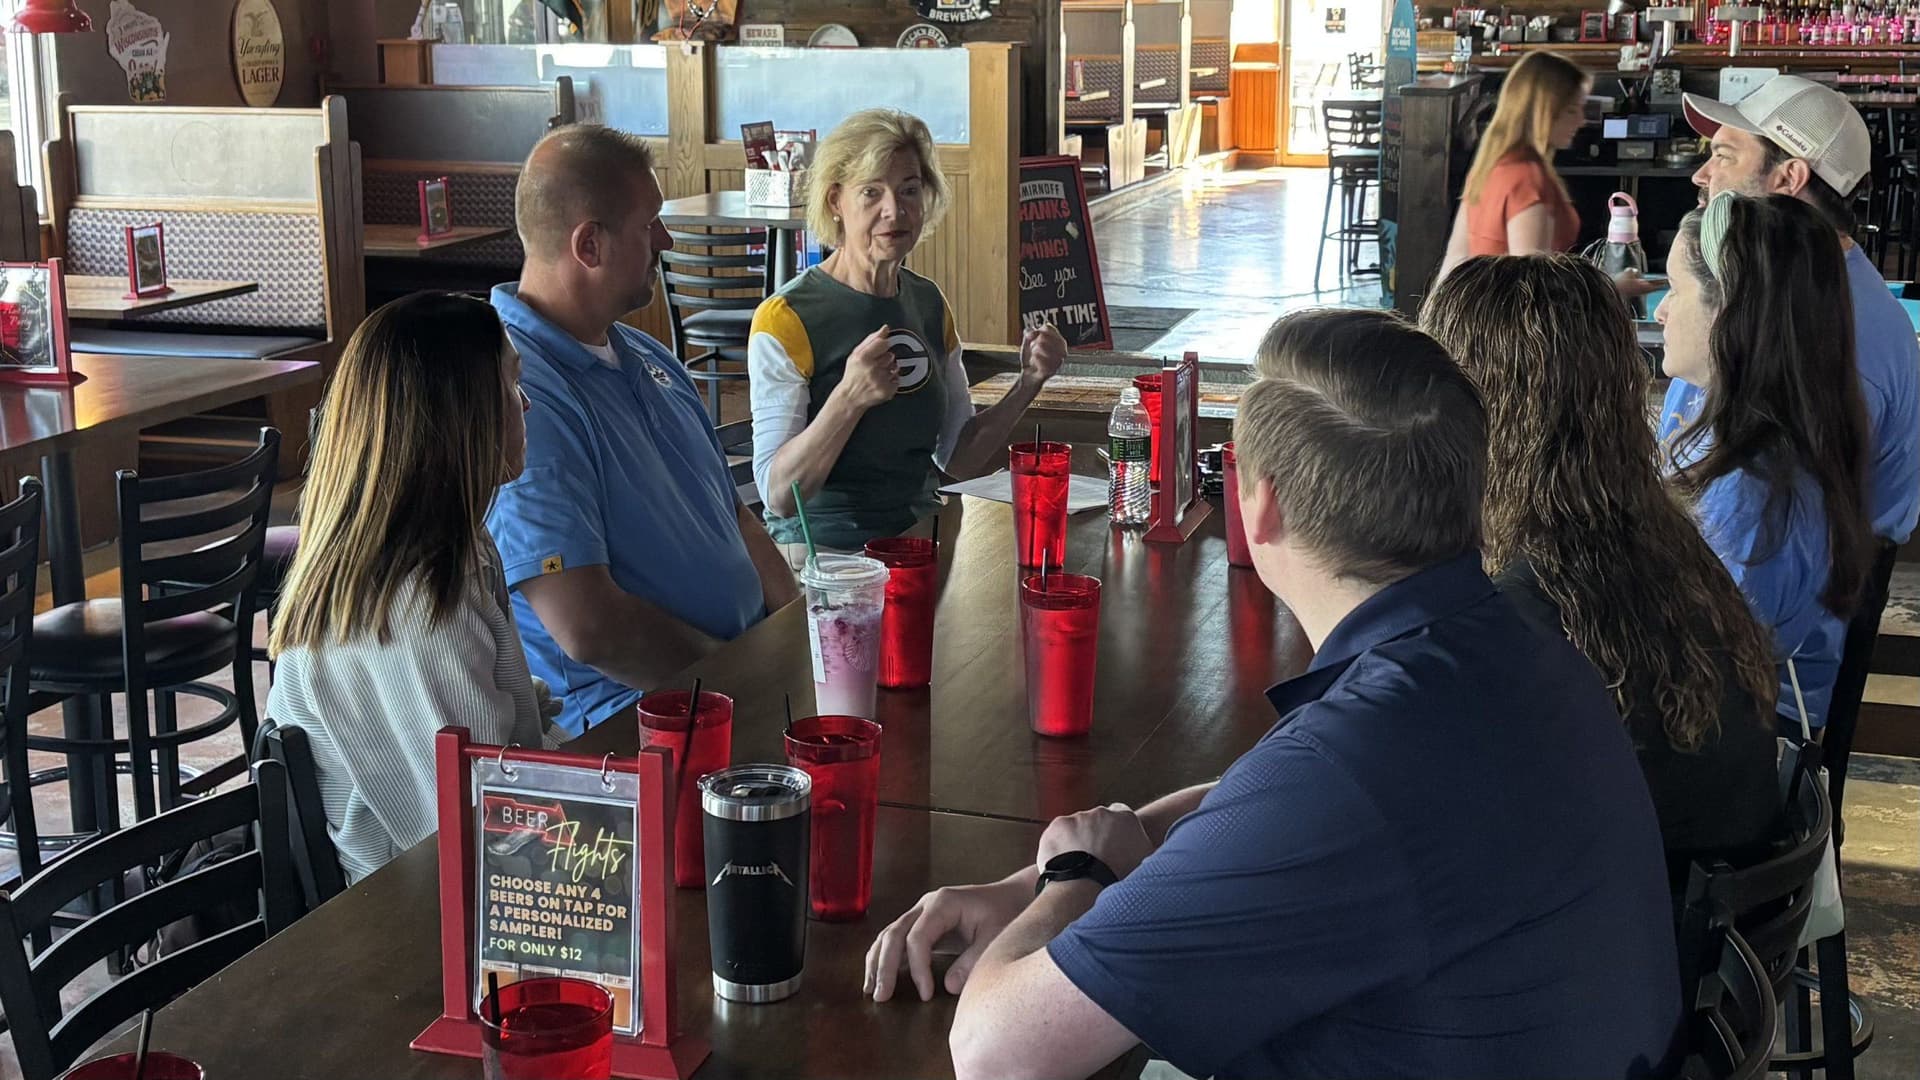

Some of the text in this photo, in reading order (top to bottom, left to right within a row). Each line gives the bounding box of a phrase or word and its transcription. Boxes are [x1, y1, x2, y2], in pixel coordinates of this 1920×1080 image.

[240, 38, 280, 57] Yuengling
[242, 66, 280, 85] LAGER
[1782, 128, 1808, 152] Columbia
[1020, 183, 1060, 197] MIRNOFF
[1019, 199, 1071, 221] HANKS
[1020, 266, 1078, 299] See you
[1023, 302, 1098, 329] NEXT TIME
[502, 806, 549, 828] BEER
[546, 820, 633, 883] Flights
[711, 859, 795, 887] METALLICA
[489, 874, 602, 901] CHOOSE ANY 4
[489, 889, 627, 919] BEERS ON TAP FOR
[489, 904, 614, 932] A PERSONALIZED
[489, 919, 562, 941] SAMPLER!
[489, 937, 582, 962] FOR ONLY $12
